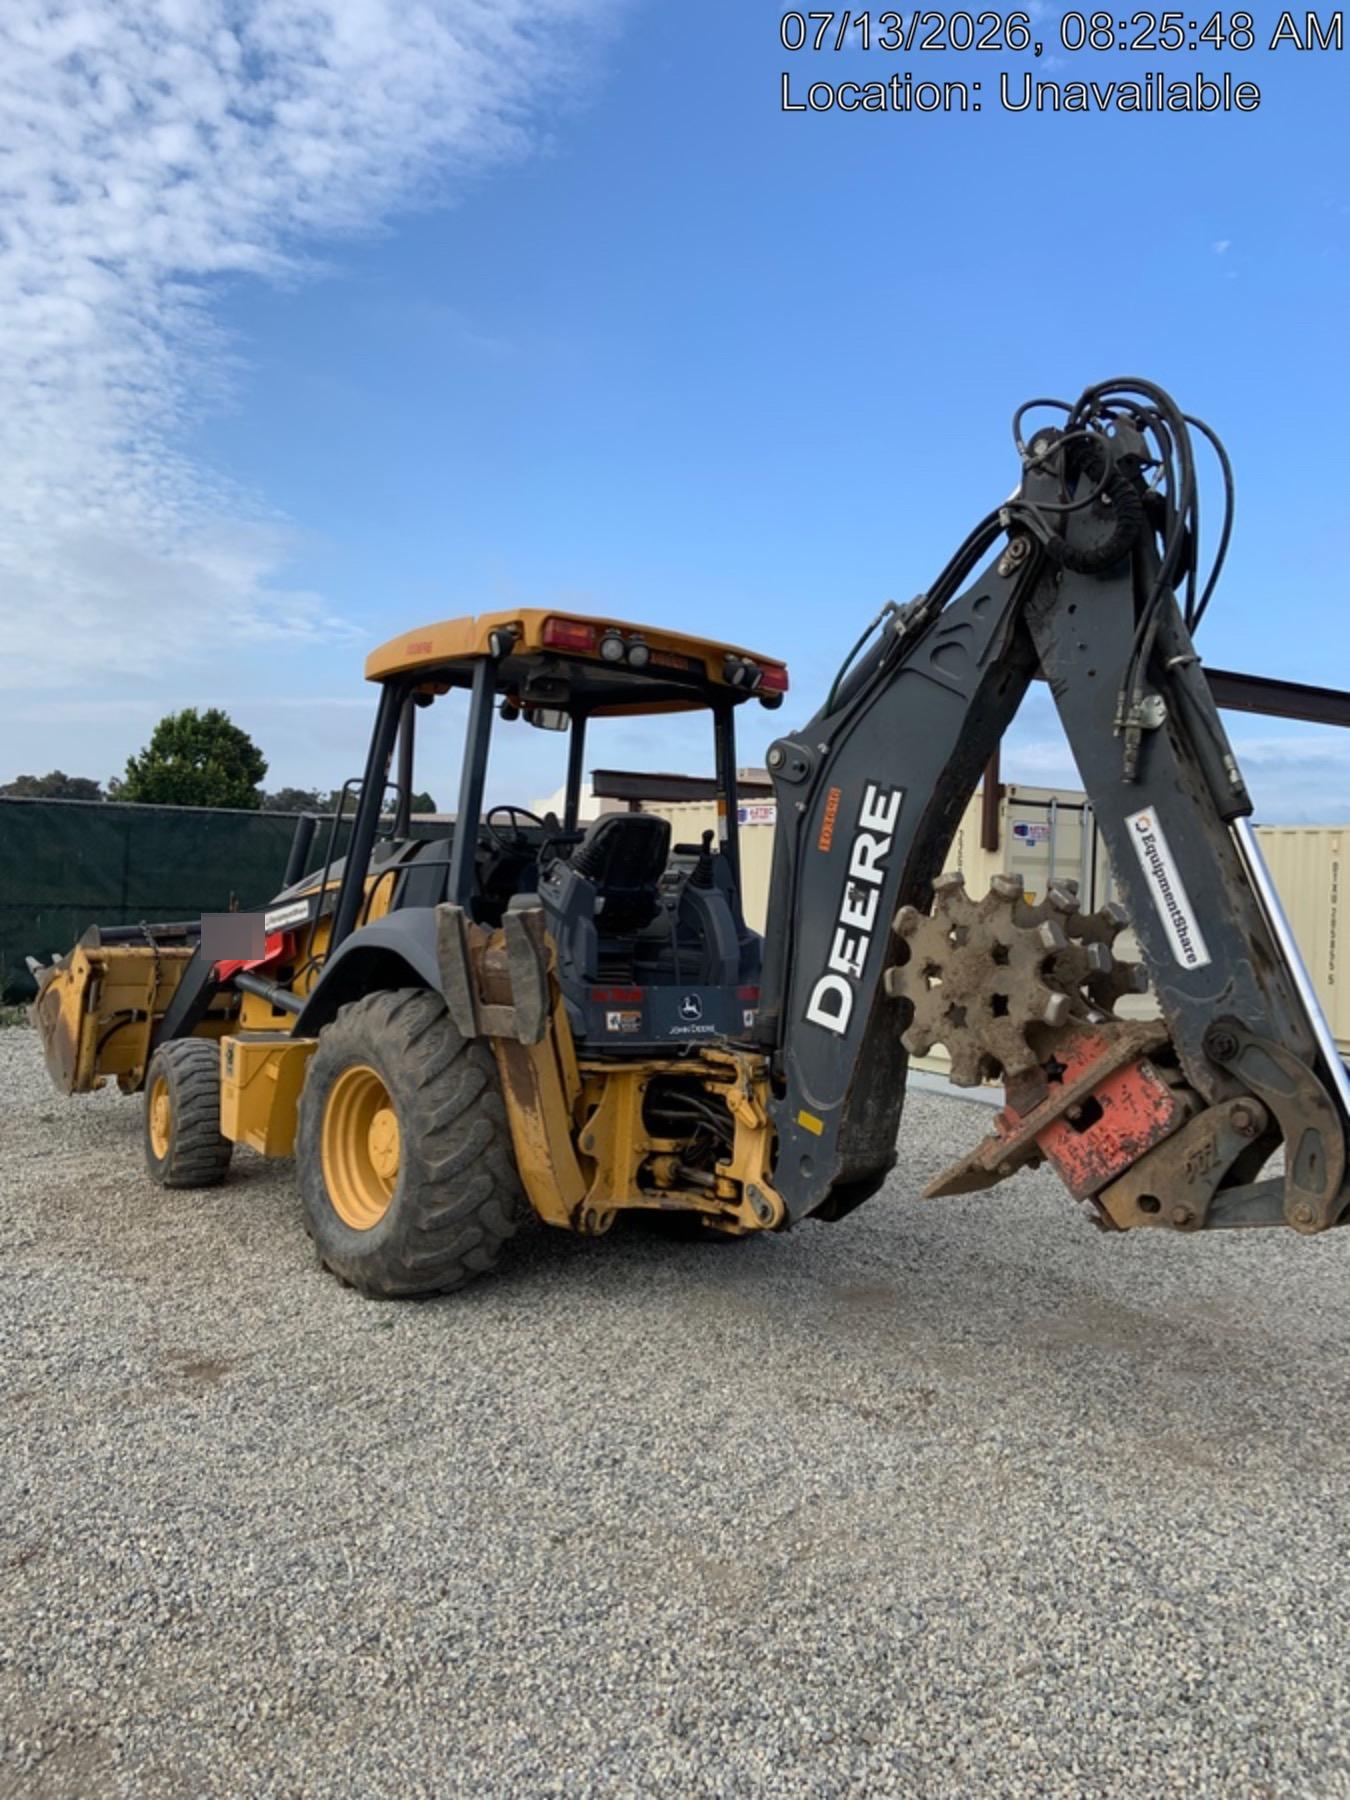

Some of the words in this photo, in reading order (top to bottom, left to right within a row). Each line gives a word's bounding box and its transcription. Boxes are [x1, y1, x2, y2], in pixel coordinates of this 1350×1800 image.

[806, 785, 903, 1034] DEERE
[1142, 834, 1198, 965] EquipmentShare
[669, 1025, 690, 1035] JOHN
[691, 1023, 716, 1033] DEERE
